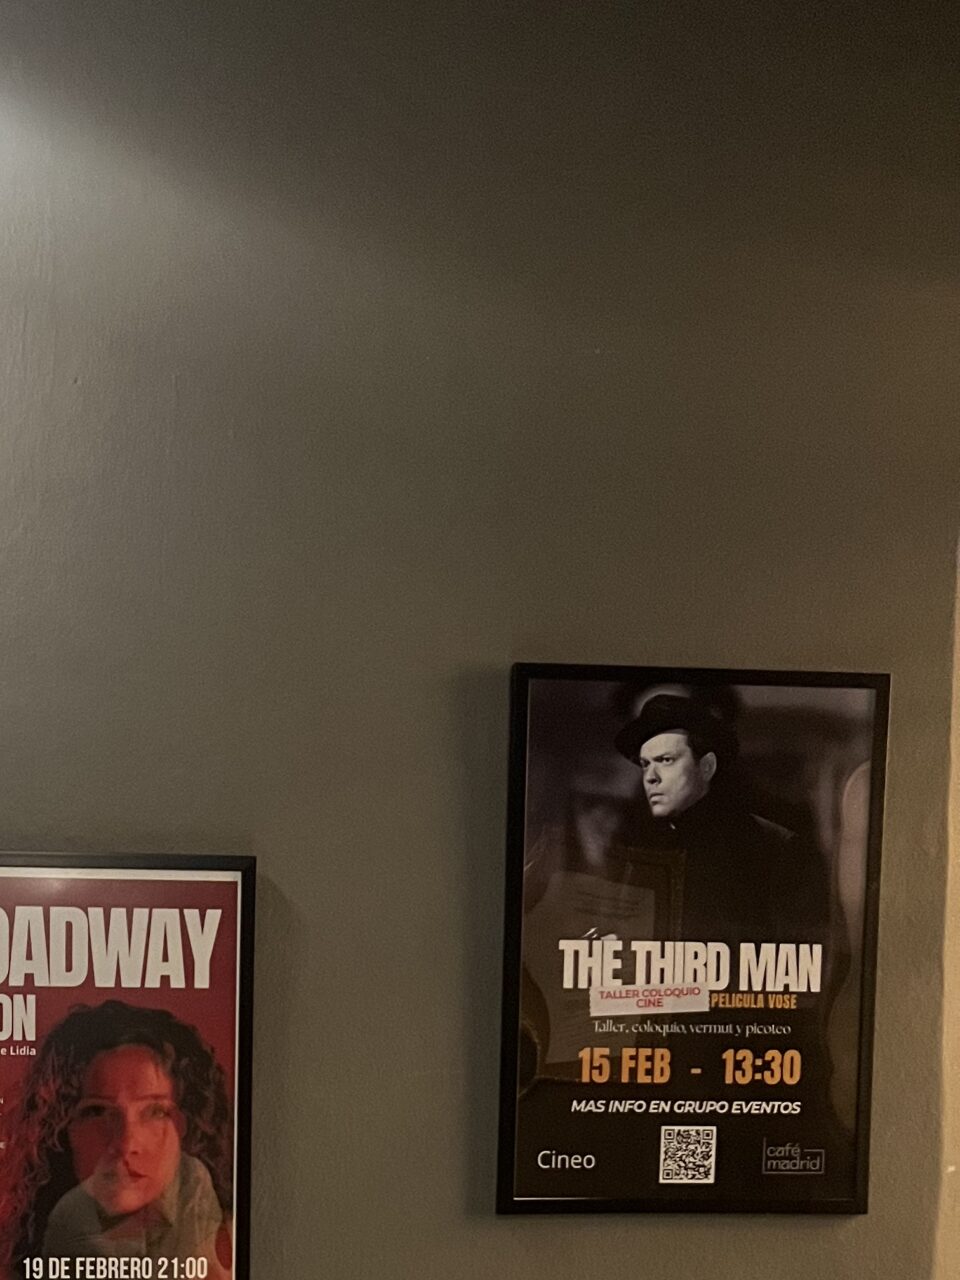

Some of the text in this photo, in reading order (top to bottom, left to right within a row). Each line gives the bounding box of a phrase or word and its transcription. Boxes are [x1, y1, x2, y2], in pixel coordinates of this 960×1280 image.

[558, 939, 823, 993] THE THIRD MAN
[598, 986, 701, 1000] TALLER COLOQUIO
[710, 992, 798, 1009] PELICULA VOSE
[636, 998, 664, 1008] CINE
[690, 1023, 733, 1034] vermut
[734, 1024, 742, 1037] y
[745, 1022, 792, 1038] picoteo
[10, 1045, 37, 1056] Lidia
[578, 1047, 611, 1084] 15
[621, 1047, 671, 1084] FEB
[721, 1048, 802, 1085] 13:30
[570, 1100, 802, 1114] MAS INFO EN GRUPO EVENTOS
[766, 1142, 801, 1158] café
[537, 1150, 596, 1169] Cineo
[767, 1155, 820, 1170] madrid
[23, 1256, 208, 1280] 19 DE FEBRERO 21:00
